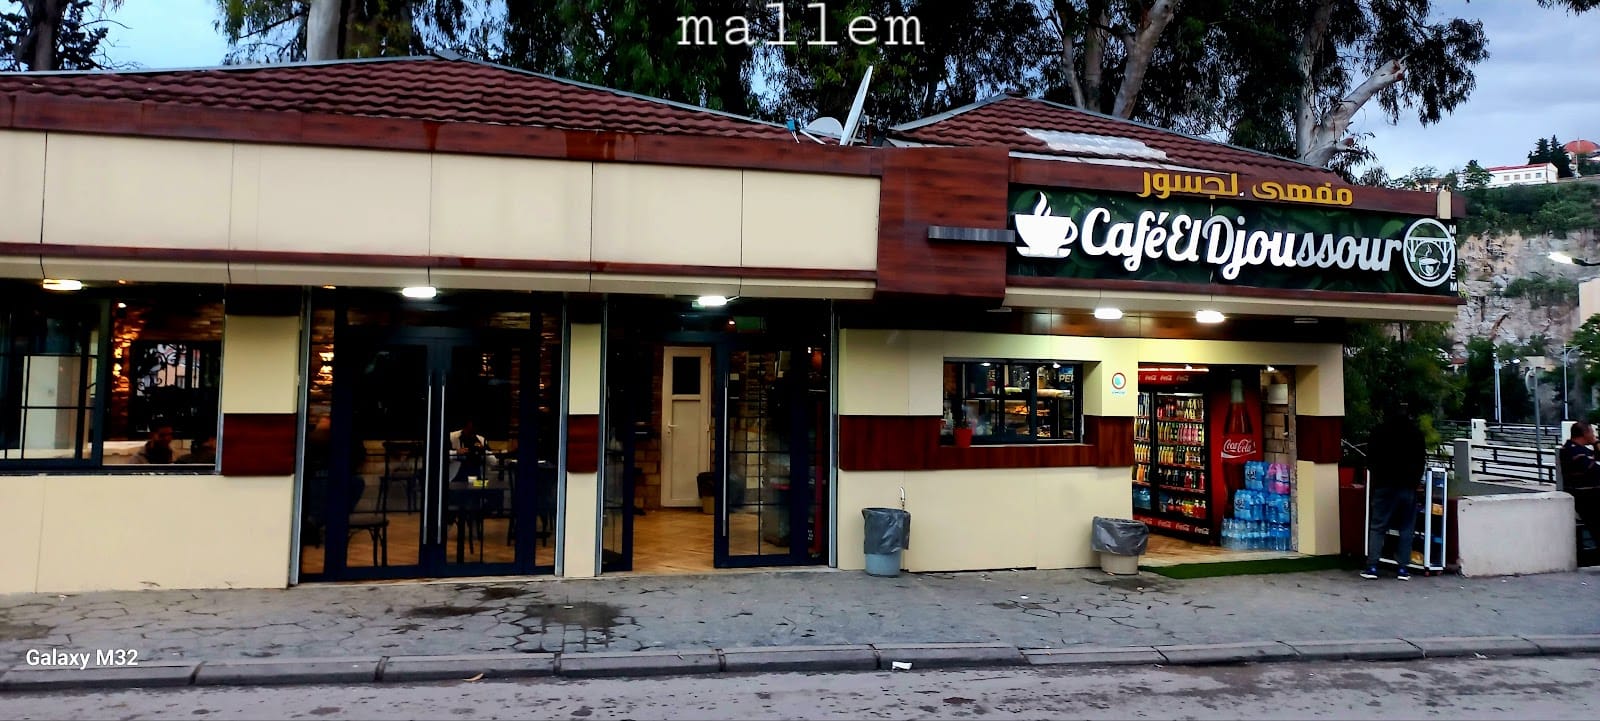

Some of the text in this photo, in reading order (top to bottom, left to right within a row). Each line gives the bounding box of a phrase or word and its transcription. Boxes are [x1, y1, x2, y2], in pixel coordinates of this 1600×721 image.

[1082, 207, 1402, 280] Café El Djoussour
